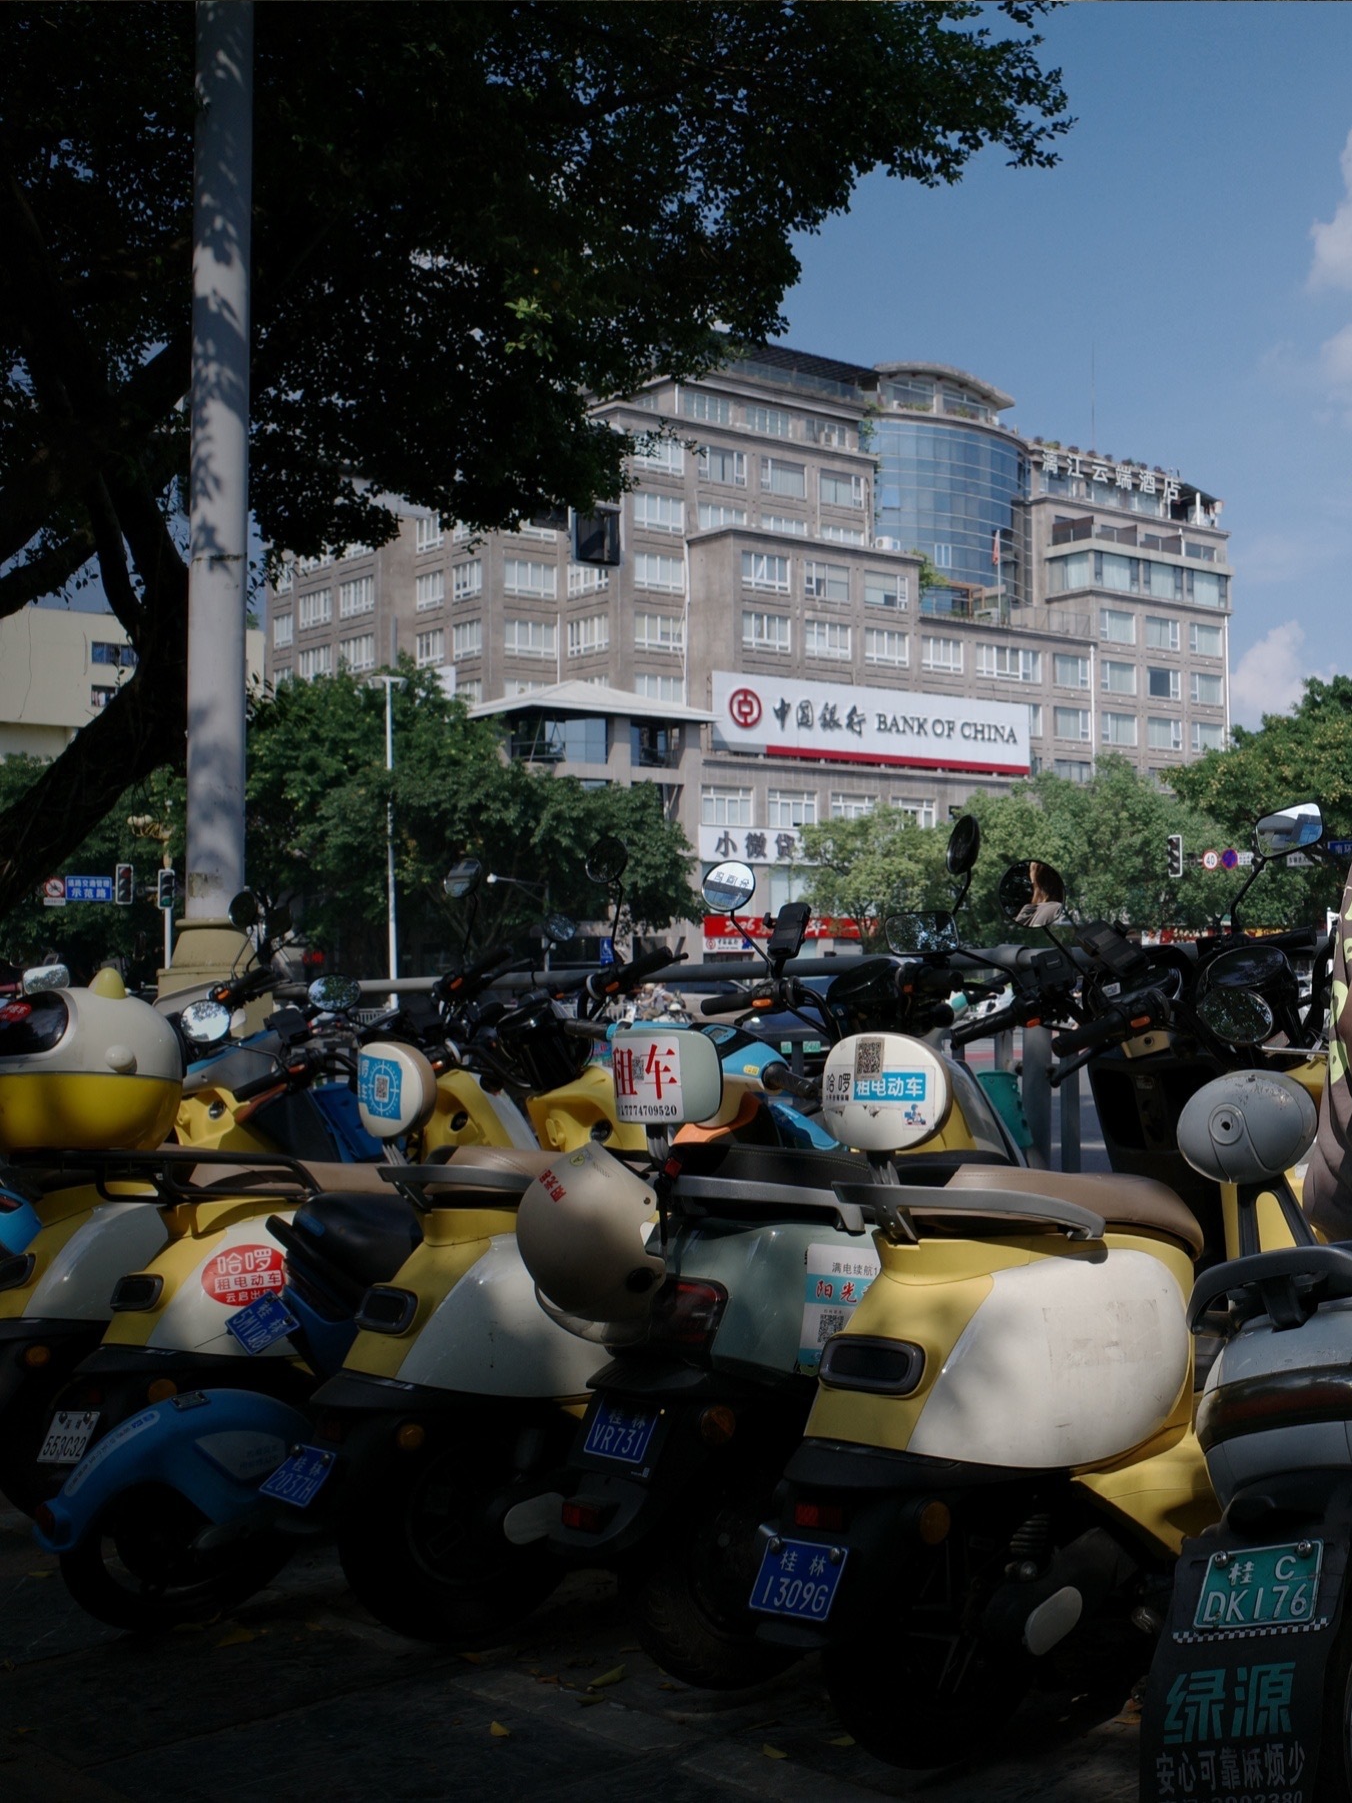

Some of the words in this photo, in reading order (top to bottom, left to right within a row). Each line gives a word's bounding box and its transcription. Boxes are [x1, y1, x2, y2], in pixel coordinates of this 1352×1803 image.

[1042, 449, 1181, 501] 漓江云端酒店
[876, 712, 929, 735] BANK
[932, 718, 955, 738] OF
[960, 721, 1018, 744] CHINA
[1207, 855, 1215, 866] 40
[856, 1076, 924, 1097] 租电动车
[217, 1248, 272, 1274] 哈啰
[217, 1272, 281, 1290] 租电动车
[816, 1281, 869, 1302] 阳光
[608, 1407, 646, 1430] 桂林
[592, 1423, 644, 1456] VR731
[292, 1456, 323, 1477] 桂林
[266, 1470, 319, 1501] 2037H
[780, 1550, 827, 1577] 桂林
[1228, 1560, 1255, 1586] 桂
[1275, 1555, 1297, 1580] C
[762, 1576, 829, 1613] 1309G
[1202, 1583, 1308, 1622] DK176
[1163, 1661, 1296, 1745] 绿源
[1156, 1740, 1305, 1795] 安心可靠麻烦少
